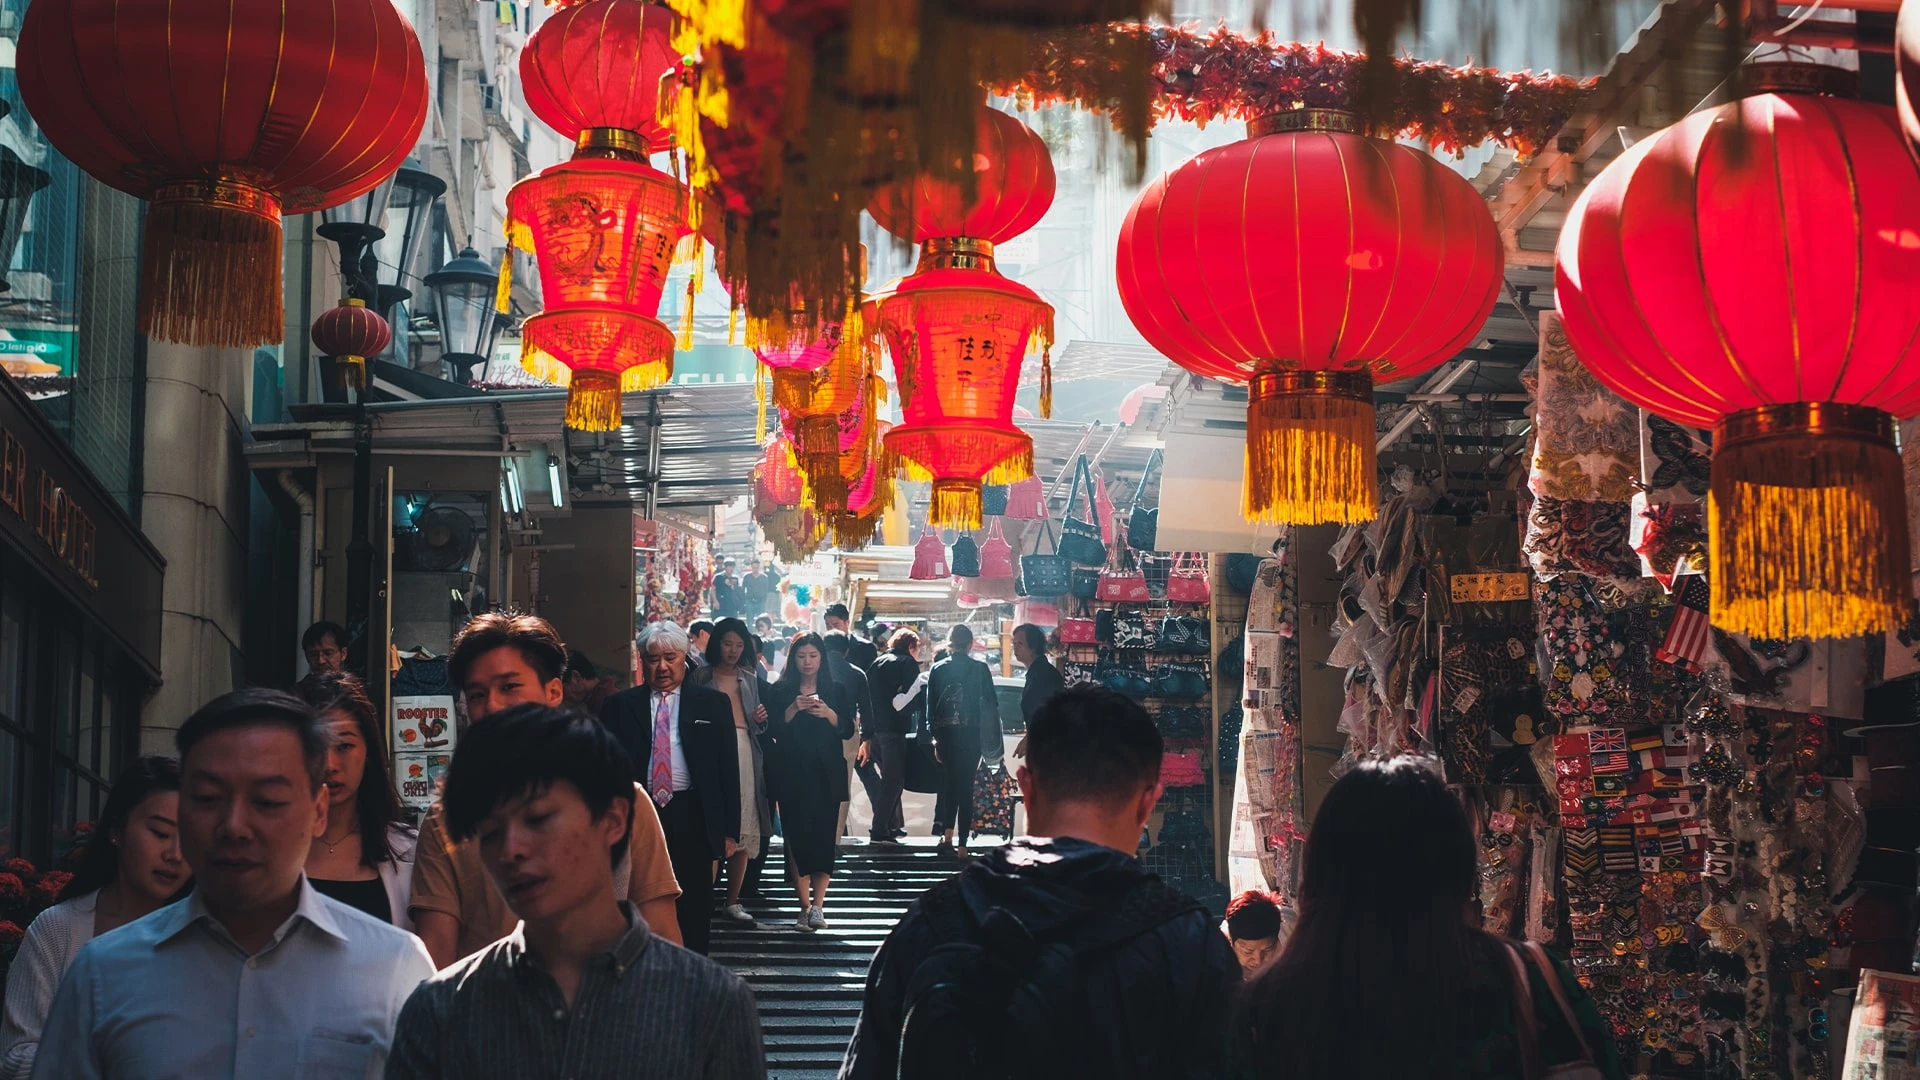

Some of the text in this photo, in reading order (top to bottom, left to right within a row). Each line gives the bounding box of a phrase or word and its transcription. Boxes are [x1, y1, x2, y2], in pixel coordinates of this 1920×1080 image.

[0, 427, 99, 589] ER HOTEL
[397, 708, 448, 720] ROOSTER
